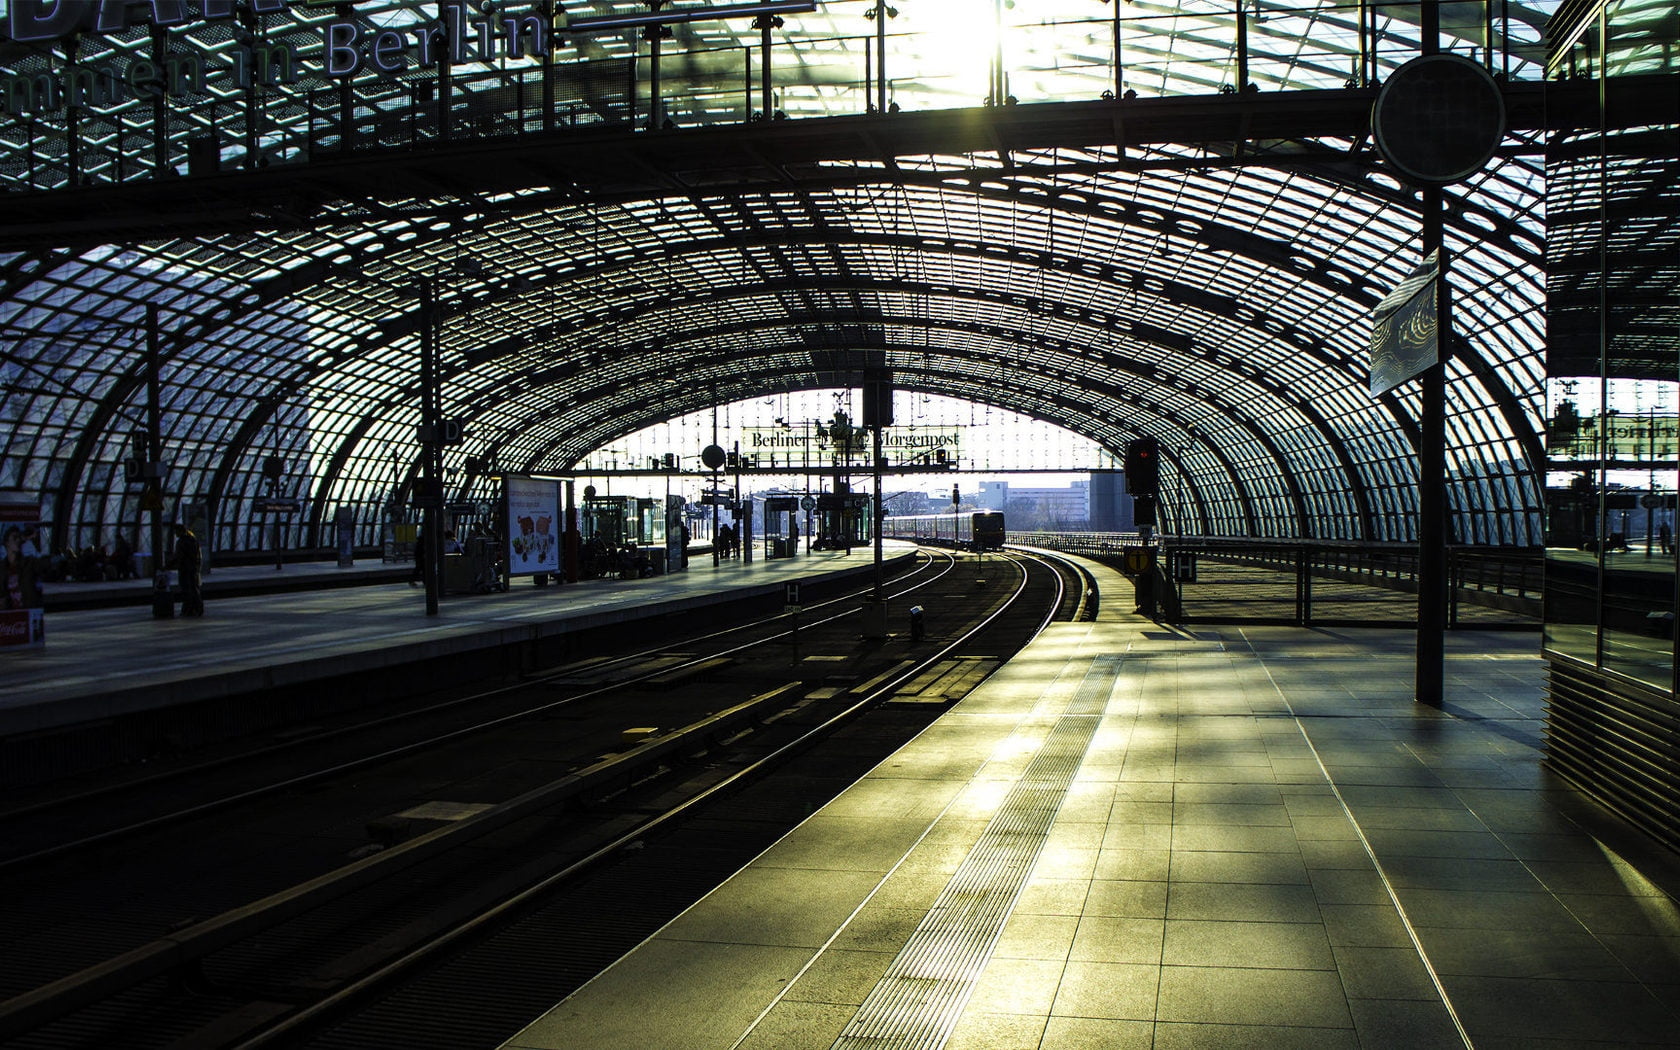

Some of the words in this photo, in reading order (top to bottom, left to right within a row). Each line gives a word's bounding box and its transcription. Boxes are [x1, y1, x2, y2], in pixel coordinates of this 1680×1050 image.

[229, 24, 299, 90] in
[322, 0, 551, 78] Berlin
[751, 430, 807, 447] Berliner
[1178, 556, 1193, 578] H
[786, 584, 799, 603] H
